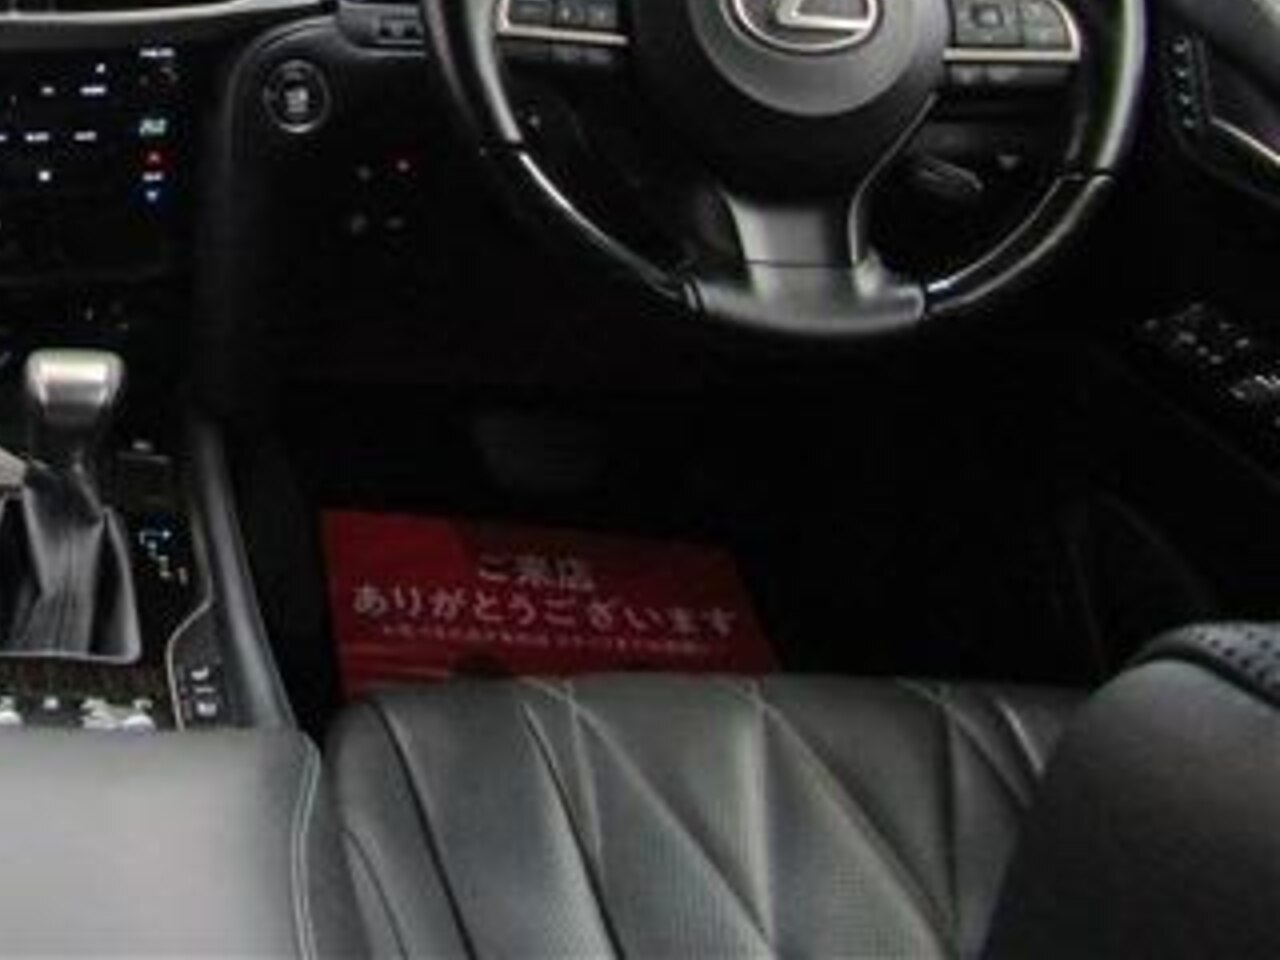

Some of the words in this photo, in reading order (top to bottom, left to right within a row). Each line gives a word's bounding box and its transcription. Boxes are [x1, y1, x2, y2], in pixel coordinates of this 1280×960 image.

[478, 551, 596, 592] ご来店
[352, 584, 737, 636] ありがとうございます
